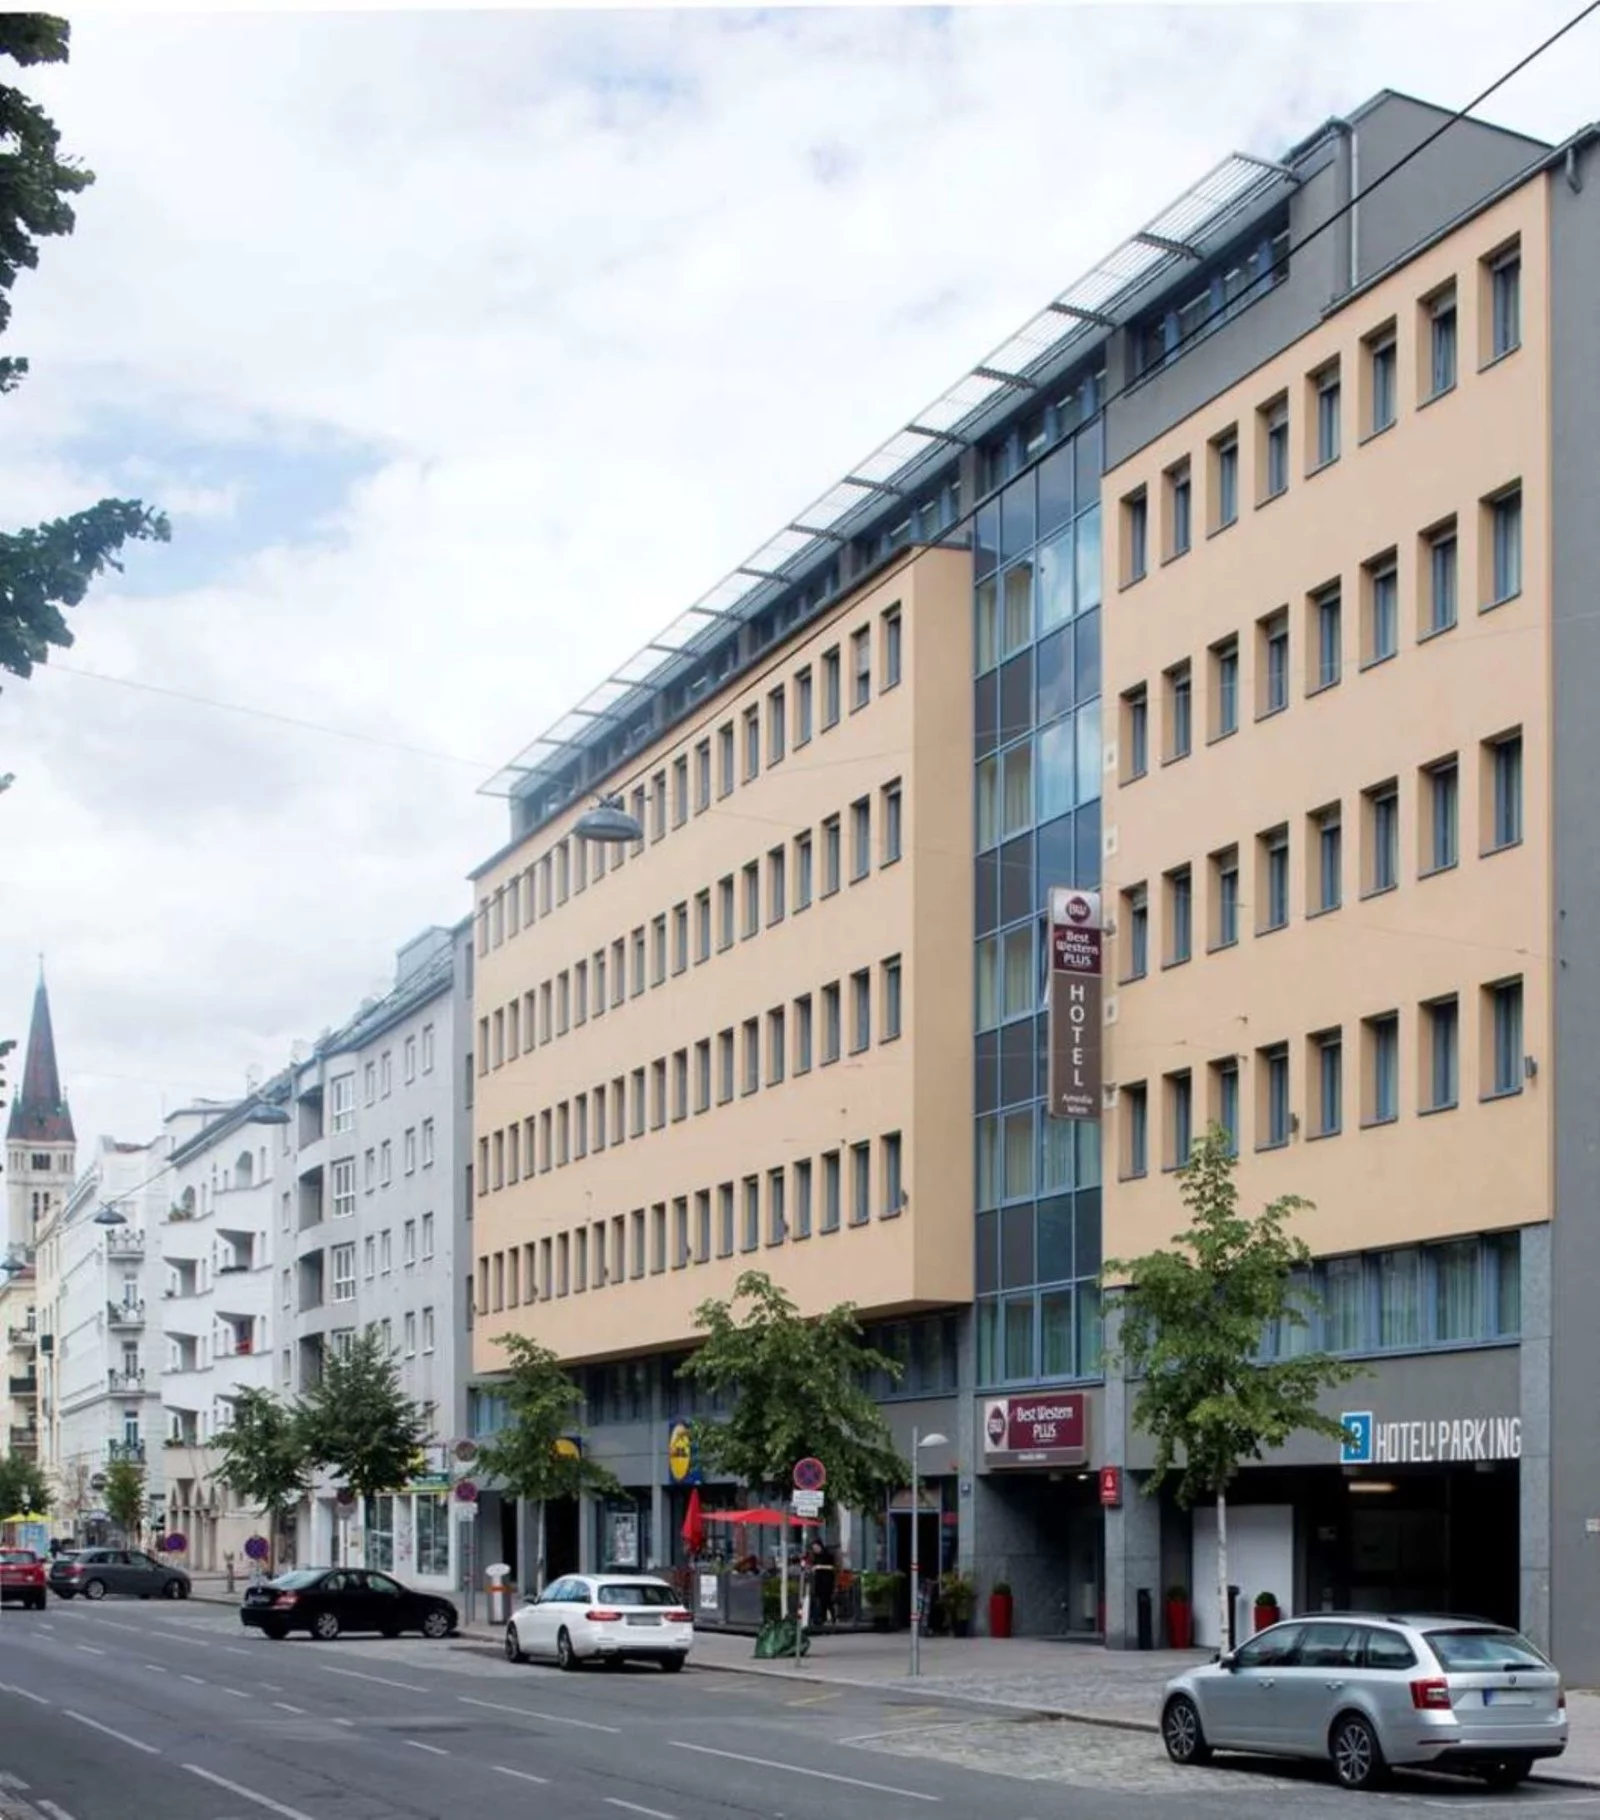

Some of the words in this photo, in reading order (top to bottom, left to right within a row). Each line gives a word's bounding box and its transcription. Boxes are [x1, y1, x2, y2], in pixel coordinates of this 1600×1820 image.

[1066, 931, 1090, 943] Best
[1056, 940, 1100, 955] Western
[1063, 952, 1092, 965] PLUS
[1069, 983, 1085, 1087] HOTEL
[1016, 1406, 1036, 1422] Best
[1037, 1405, 1073, 1421] Western
[1032, 1423, 1057, 1438] PLUS
